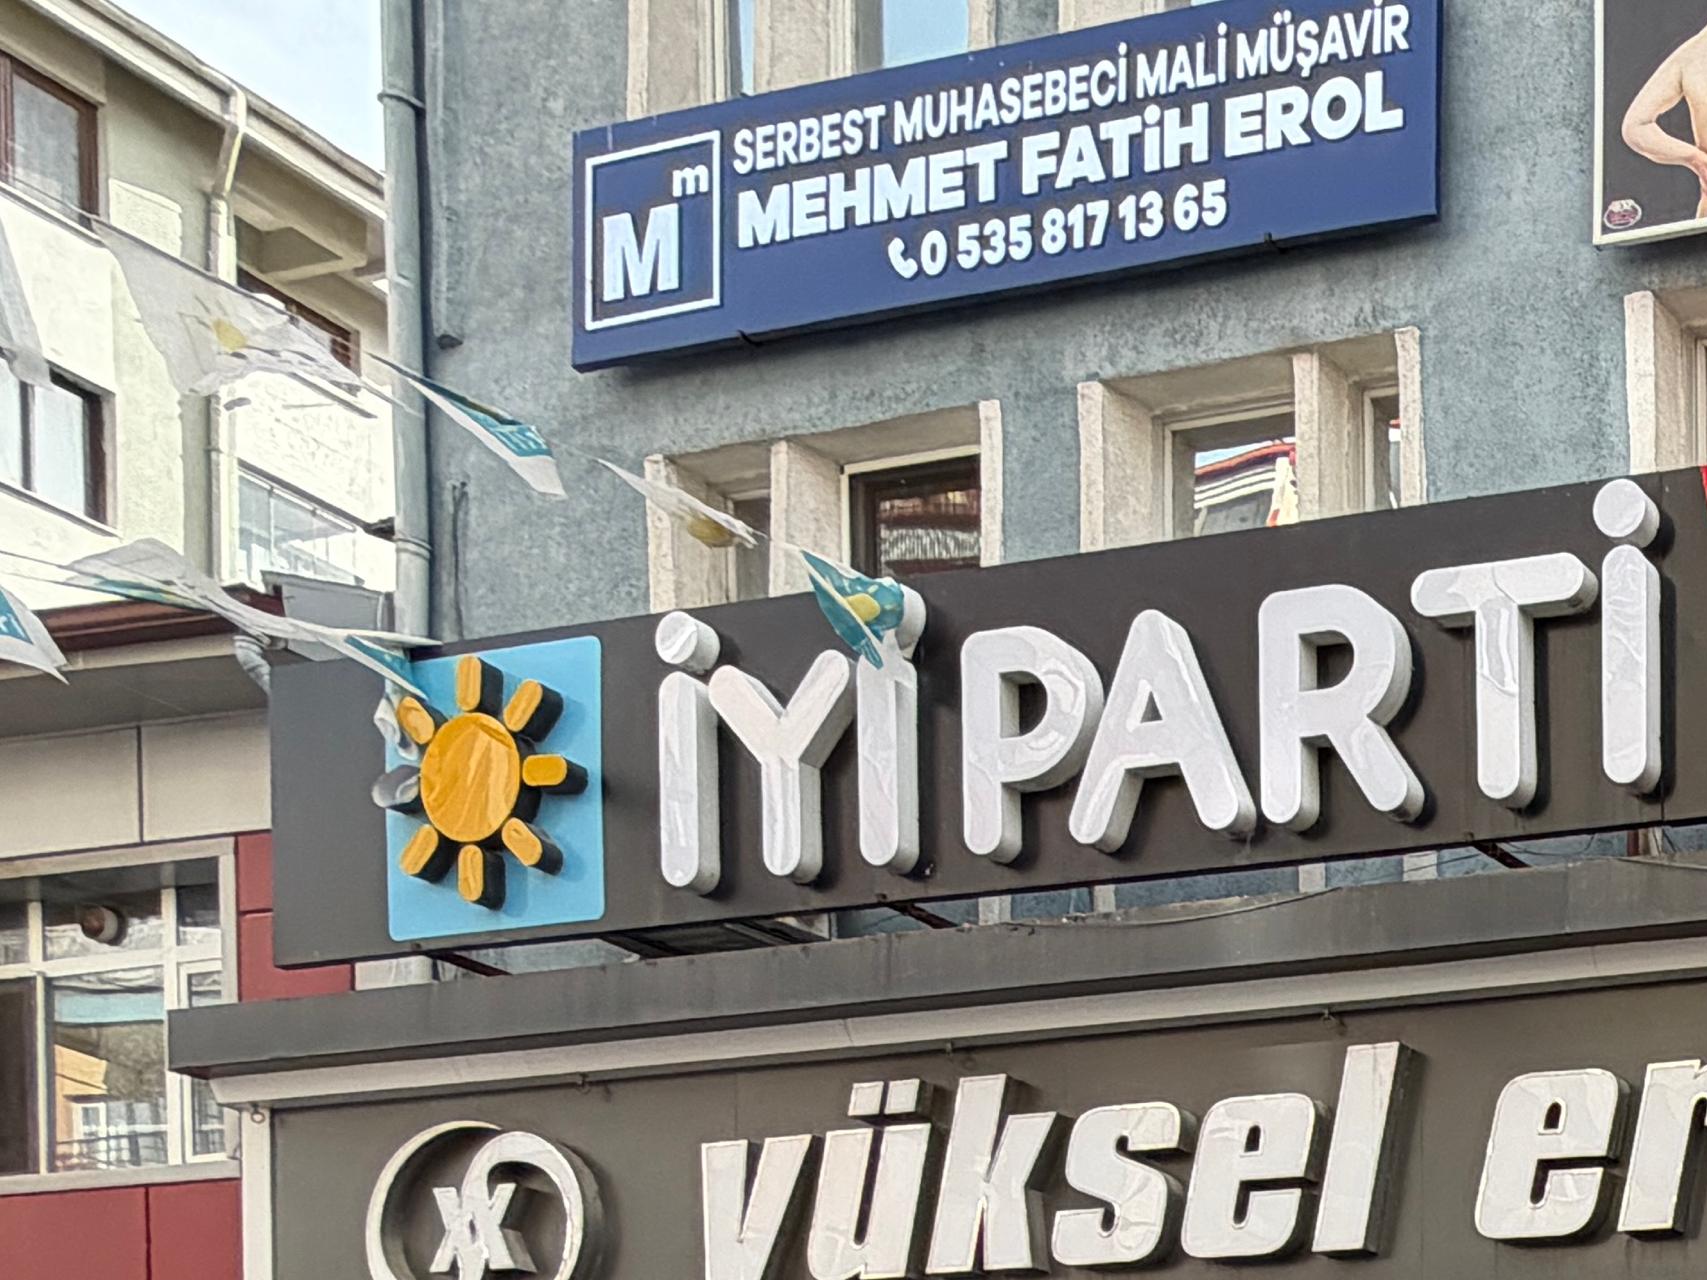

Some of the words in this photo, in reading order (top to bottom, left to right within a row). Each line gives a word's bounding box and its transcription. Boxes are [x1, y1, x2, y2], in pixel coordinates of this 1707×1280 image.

[733, 104, 884, 175] SERBEST
[892, 43, 1129, 141] MUHASEBECİ
[1136, 22, 1227, 99] MALİ
[1235, 1, 1411, 84] MÜŞAVİR
[737, 139, 1008, 250] MEHMET
[1020, 104, 1211, 197] FATİH
[1223, 69, 1403, 158] EROL
[920, 231, 949, 276] 0
[956, 212, 1033, 271] 535
[1040, 202, 1111, 257] 817
[1118, 193, 1167, 245] 13
[1172, 177, 1227, 233] 65
[654, 577, 926, 895] İYİ
[961, 477, 1661, 865] PARTİ
